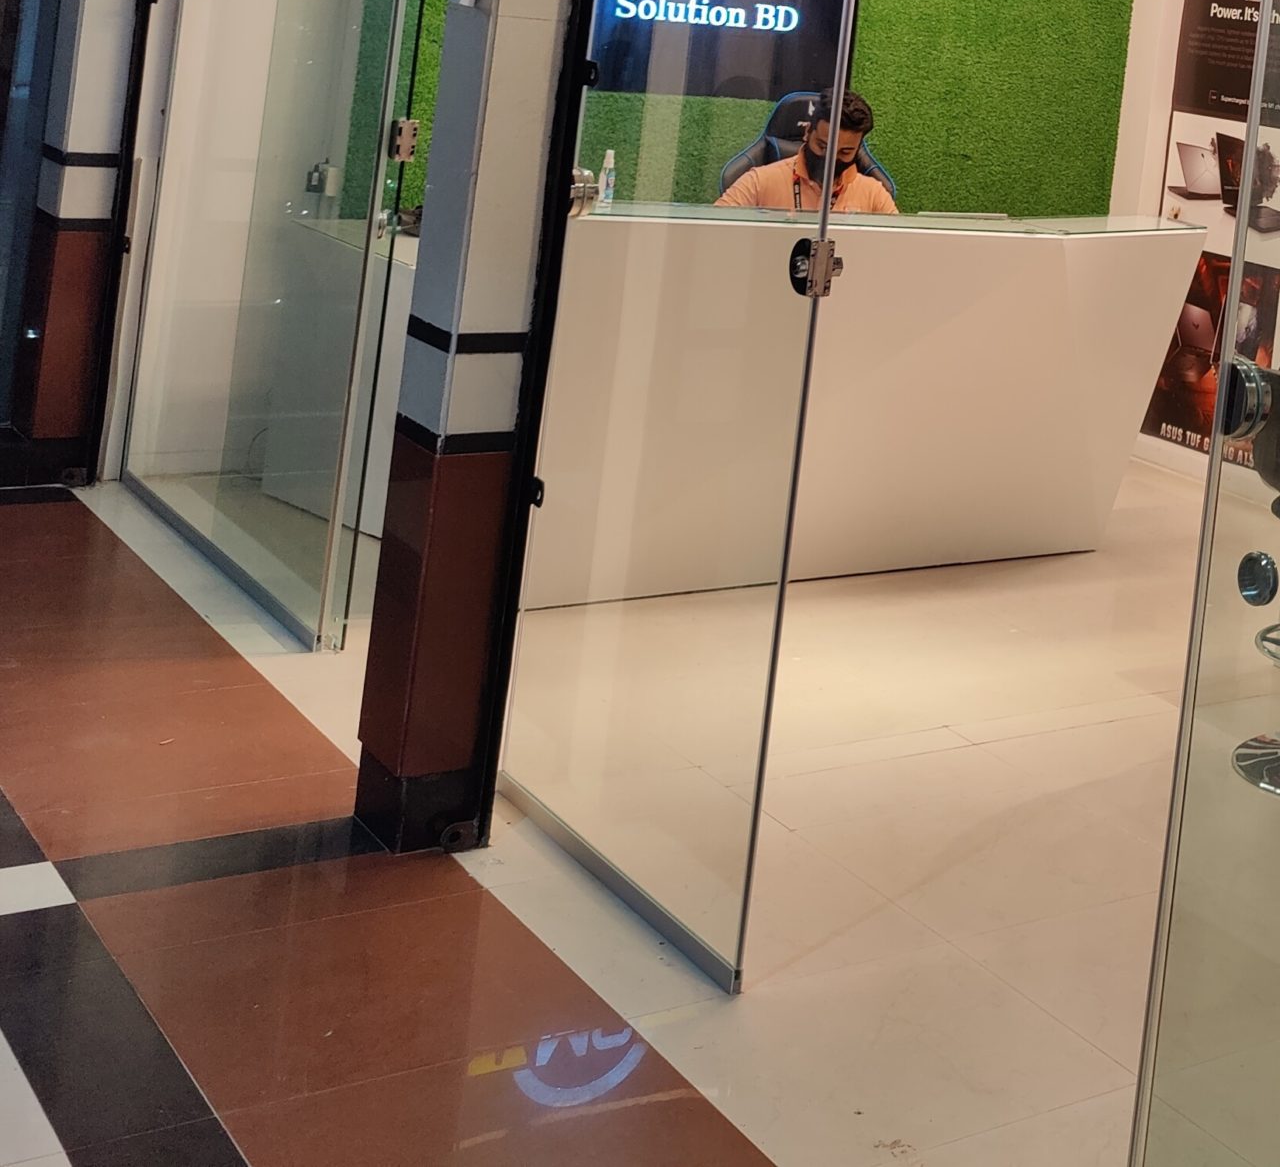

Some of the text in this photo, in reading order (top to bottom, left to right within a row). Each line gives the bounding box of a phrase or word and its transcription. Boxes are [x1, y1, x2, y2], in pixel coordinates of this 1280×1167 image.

[754, 3, 799, 32] BD
[1210, 3, 1243, 21] Power.
[1160, 423, 1183, 442] ASUS
[1186, 430, 1201, 448] TUF
[1204, 437, 1234, 460] GNG
